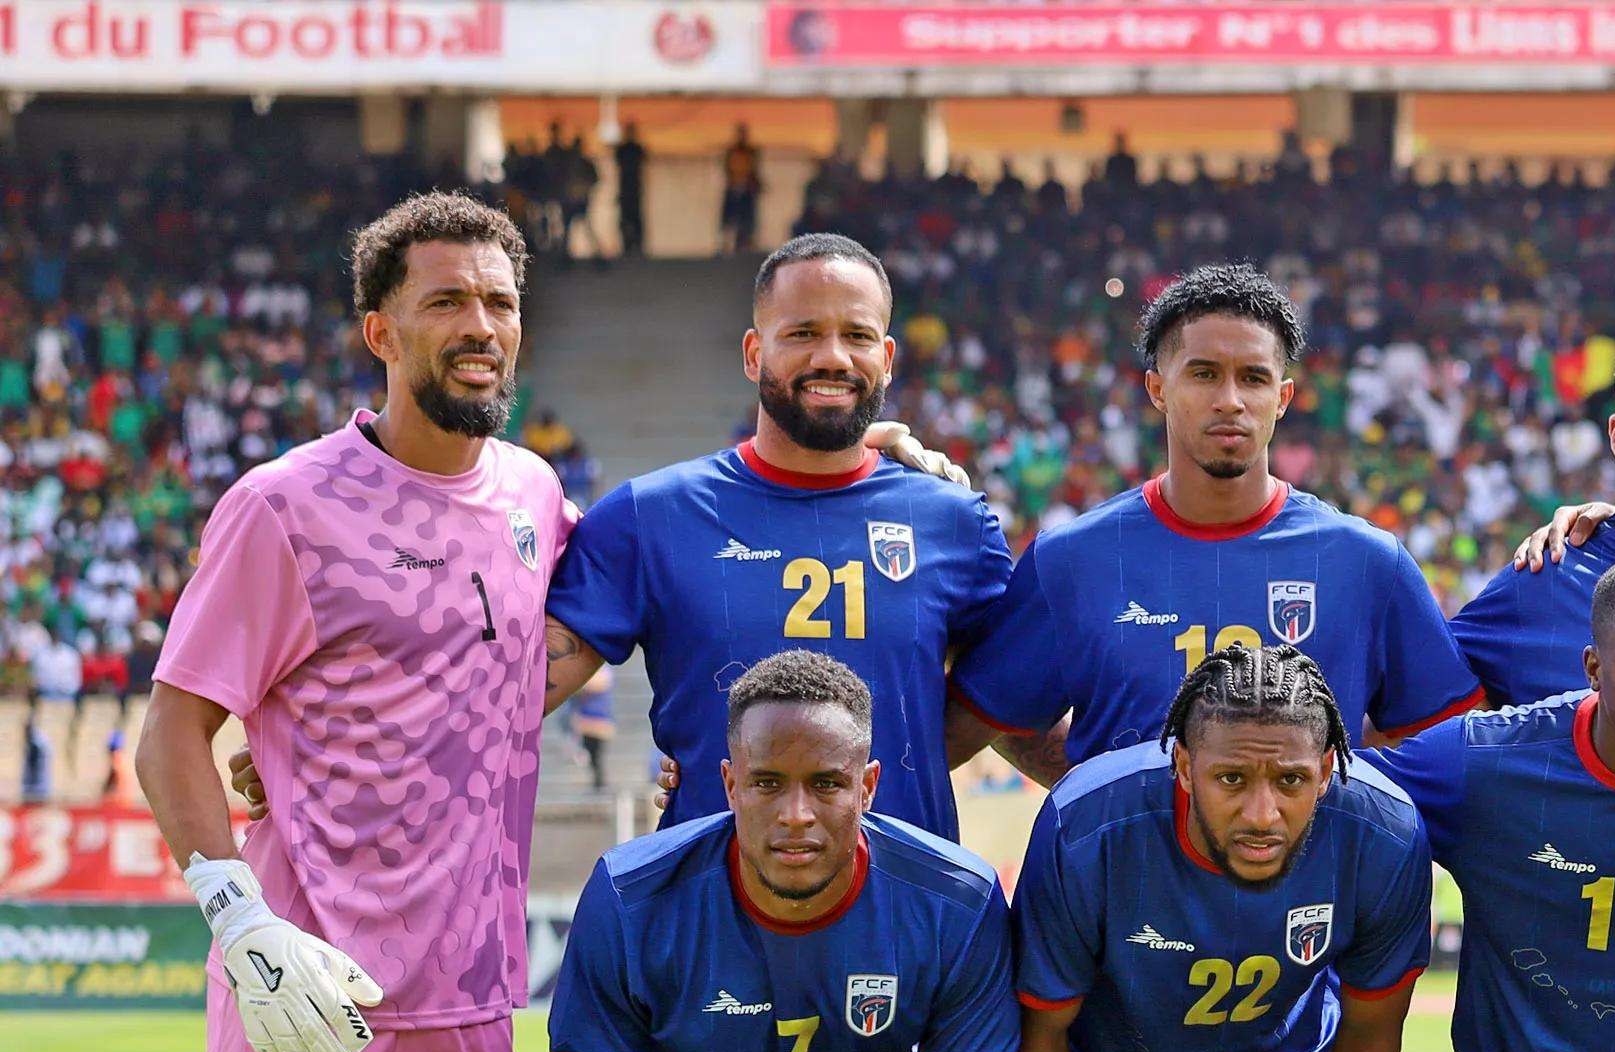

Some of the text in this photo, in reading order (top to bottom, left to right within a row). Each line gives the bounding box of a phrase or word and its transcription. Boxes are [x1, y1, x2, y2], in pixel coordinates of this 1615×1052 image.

[53, 0, 150, 58] du
[872, 526, 908, 536] FCF
[737, 549, 781, 562] tempo
[406, 556, 445, 571] tempo
[1272, 585, 1310, 595] FCF
[471, 571, 497, 641] 1
[783, 558, 866, 640] 21
[1135, 613, 1179, 626] tempo
[1550, 859, 1596, 874] tempo
[1291, 907, 1330, 922] FCF
[1150, 939, 1195, 952] tempo
[851, 979, 893, 990] FCF
[1183, 954, 1282, 1027] 22
[726, 1001, 772, 1016] tempo
